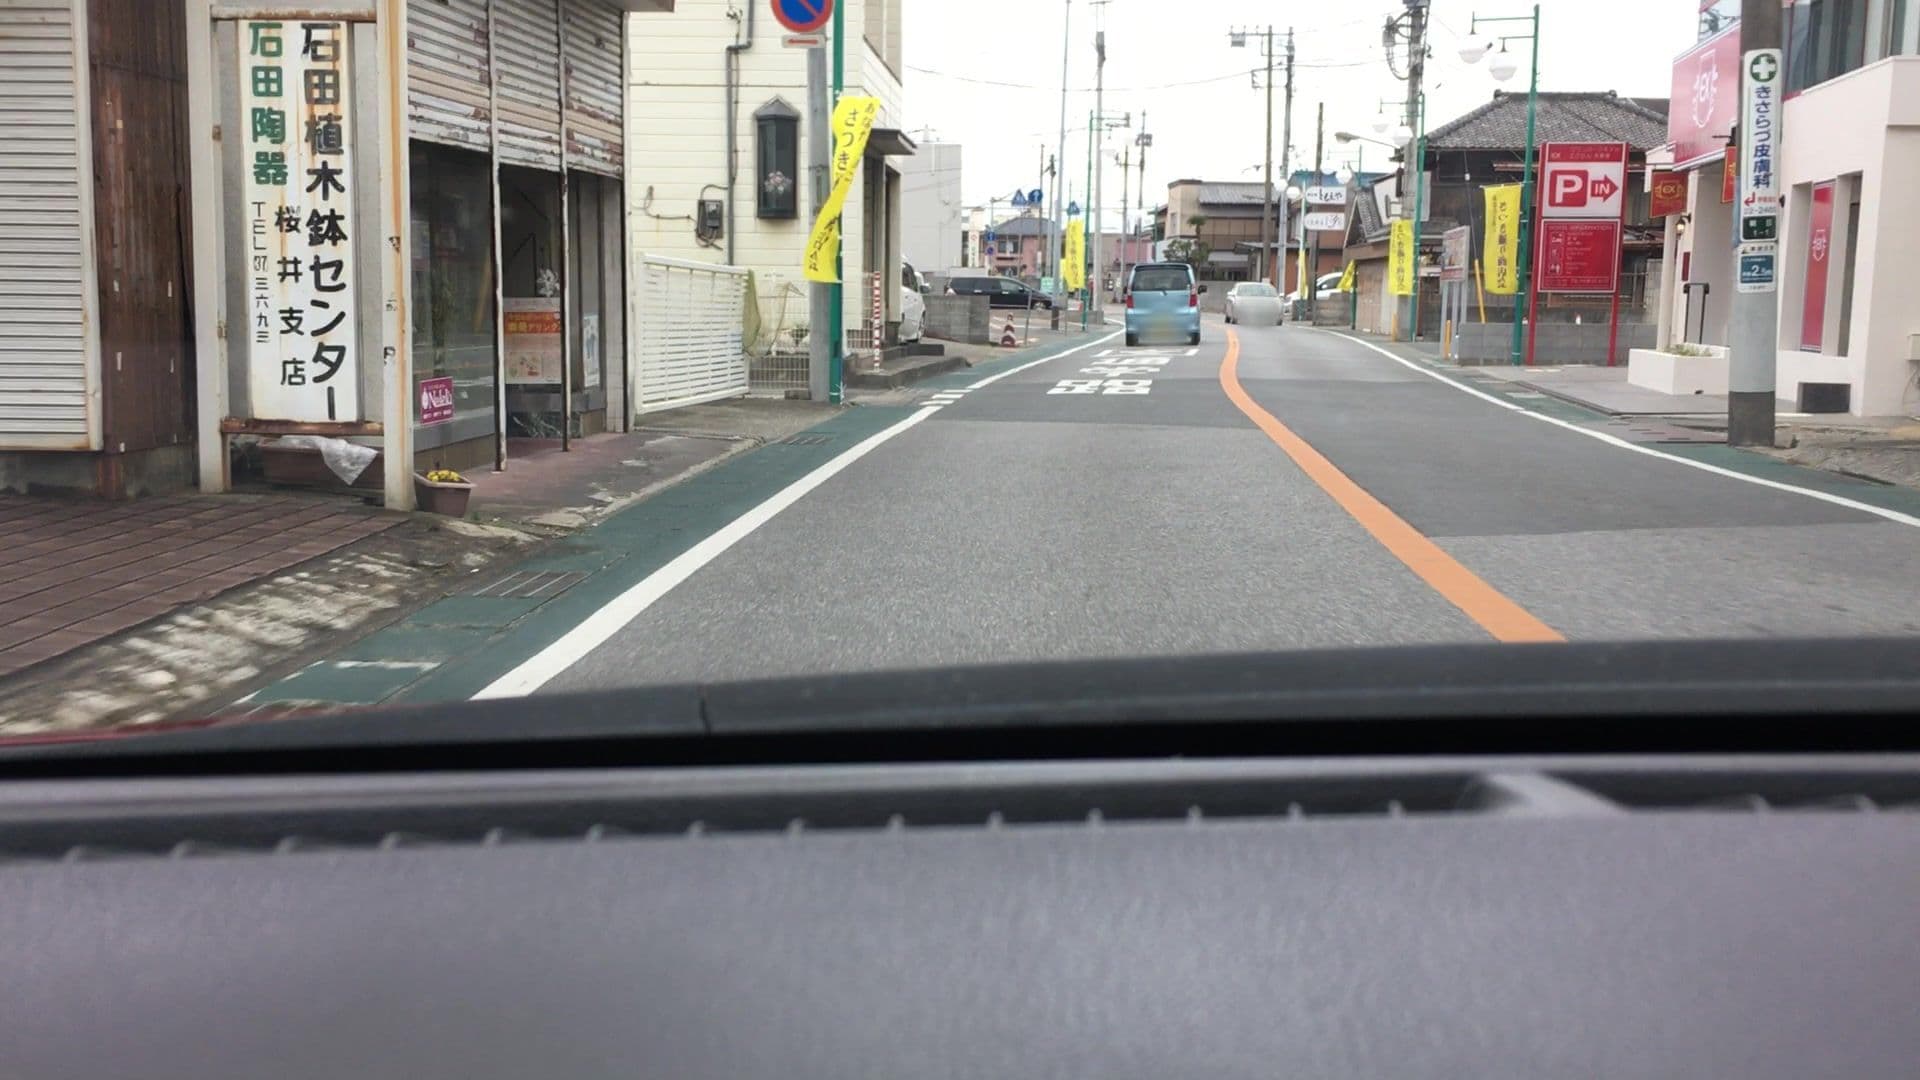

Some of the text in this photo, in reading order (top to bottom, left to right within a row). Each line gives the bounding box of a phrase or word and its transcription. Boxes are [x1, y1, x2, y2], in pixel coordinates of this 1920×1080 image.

[249, 22, 289, 187] 石田陶器
[302, 22, 347, 421] 石田植木鉢センター
[1555, 175, 1583, 204] P
[1594, 183, 1611, 195] IN
[274, 205, 306, 386] 桜井支店
